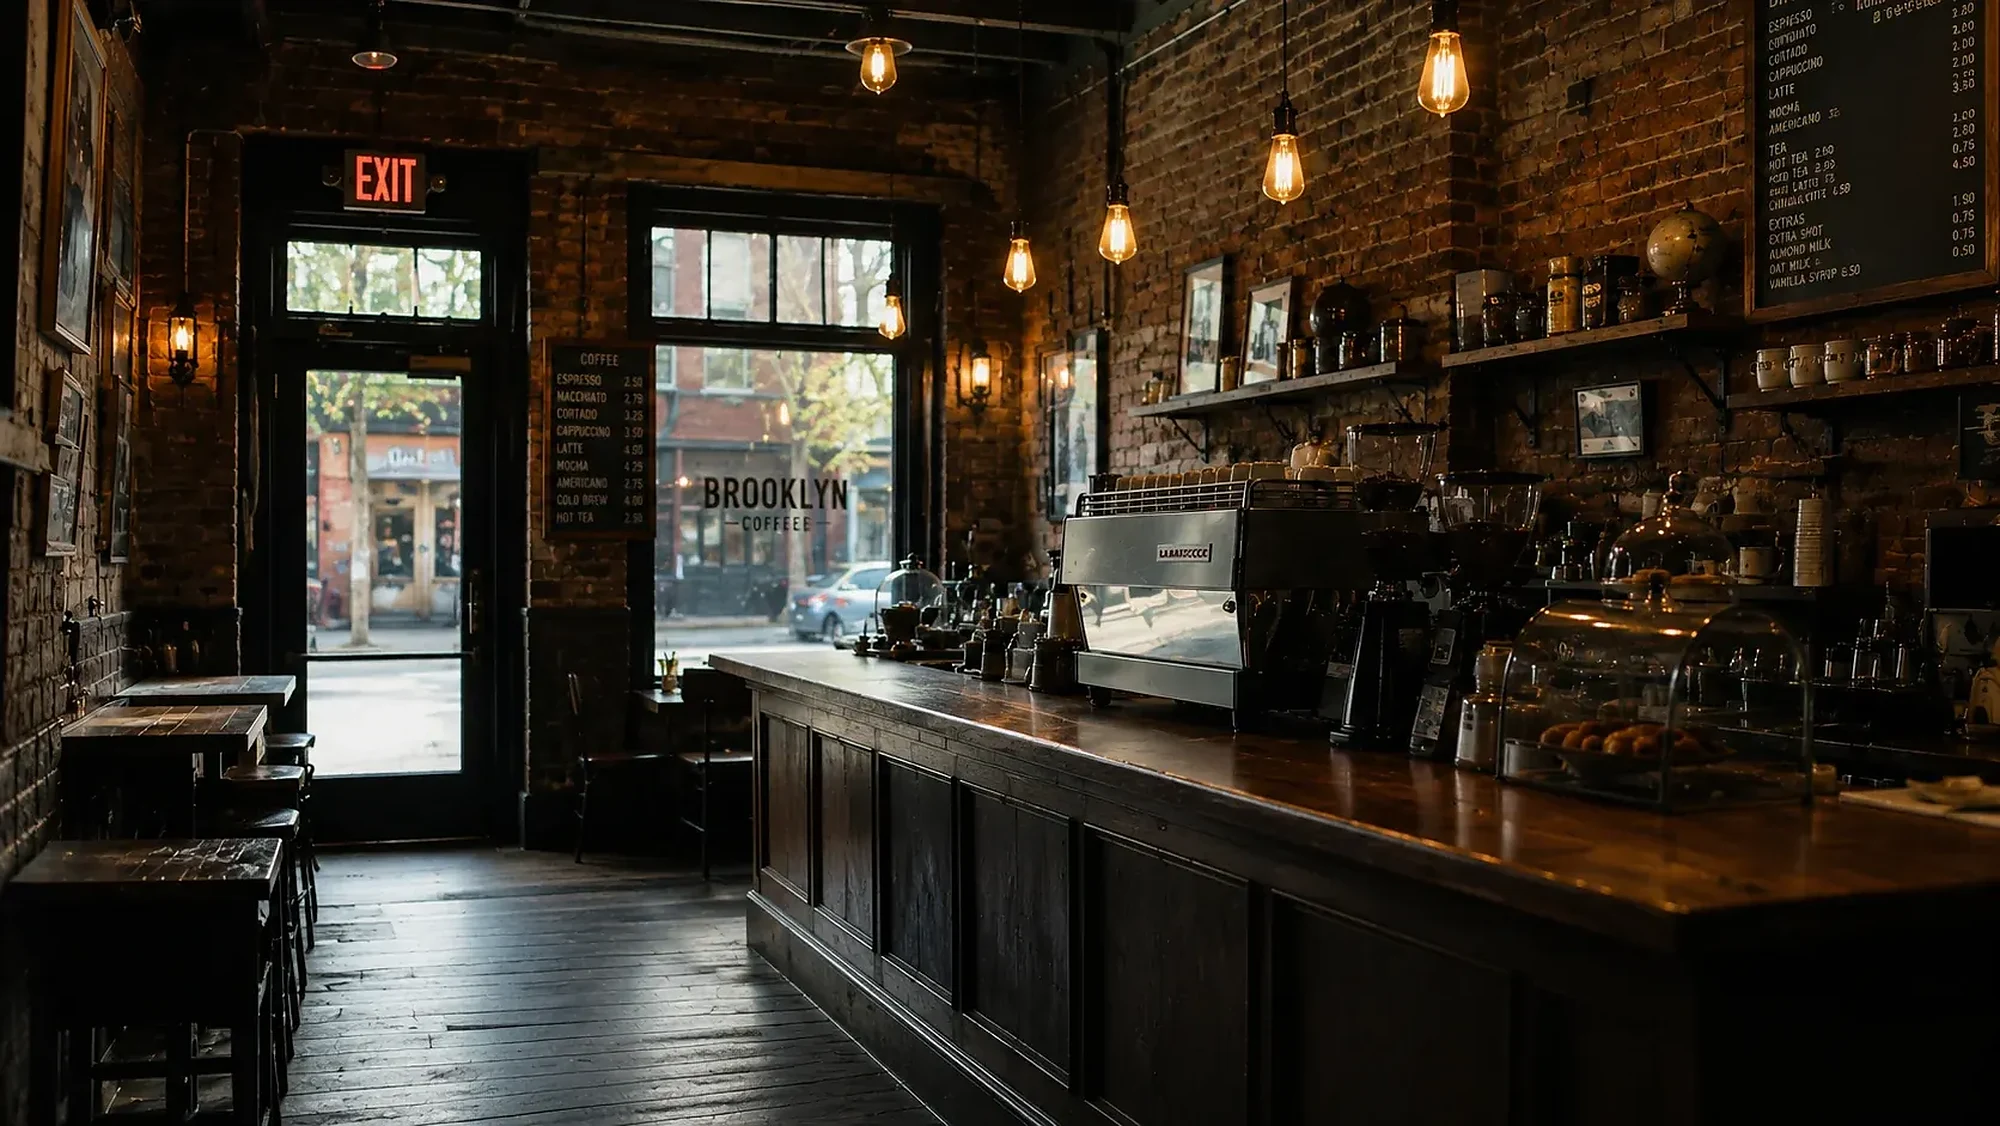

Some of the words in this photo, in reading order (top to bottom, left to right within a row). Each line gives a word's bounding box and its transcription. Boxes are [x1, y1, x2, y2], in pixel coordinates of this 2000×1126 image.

[1768, 82, 1795, 100] LATTE
[1768, 100, 1800, 119] MOCHA
[1768, 142, 1787, 157] TEA
[356, 155, 416, 202] EXIT
[1768, 212, 1805, 232] EXTRAS
[1800, 224, 1824, 240] SHOT
[1809, 238, 1832, 253] MILK
[1952, 244, 1975, 257] 0.50
[1770, 262, 1786, 275] OAT
[580, 352, 618, 366] COFFEE
[556, 373, 602, 386] ESPRESSO
[556, 408, 598, 420] CORTADO
[556, 442, 584, 454] LATTE
[556, 460, 588, 472] MOCHA
[556, 477, 608, 488] AMERICANO
[556, 494, 580, 506] COLD
[704, 477, 848, 510] BROOKLYN
[556, 512, 574, 524] HOT
[577, 512, 594, 523] TEA
[742, 516, 812, 532] COFFEEE
